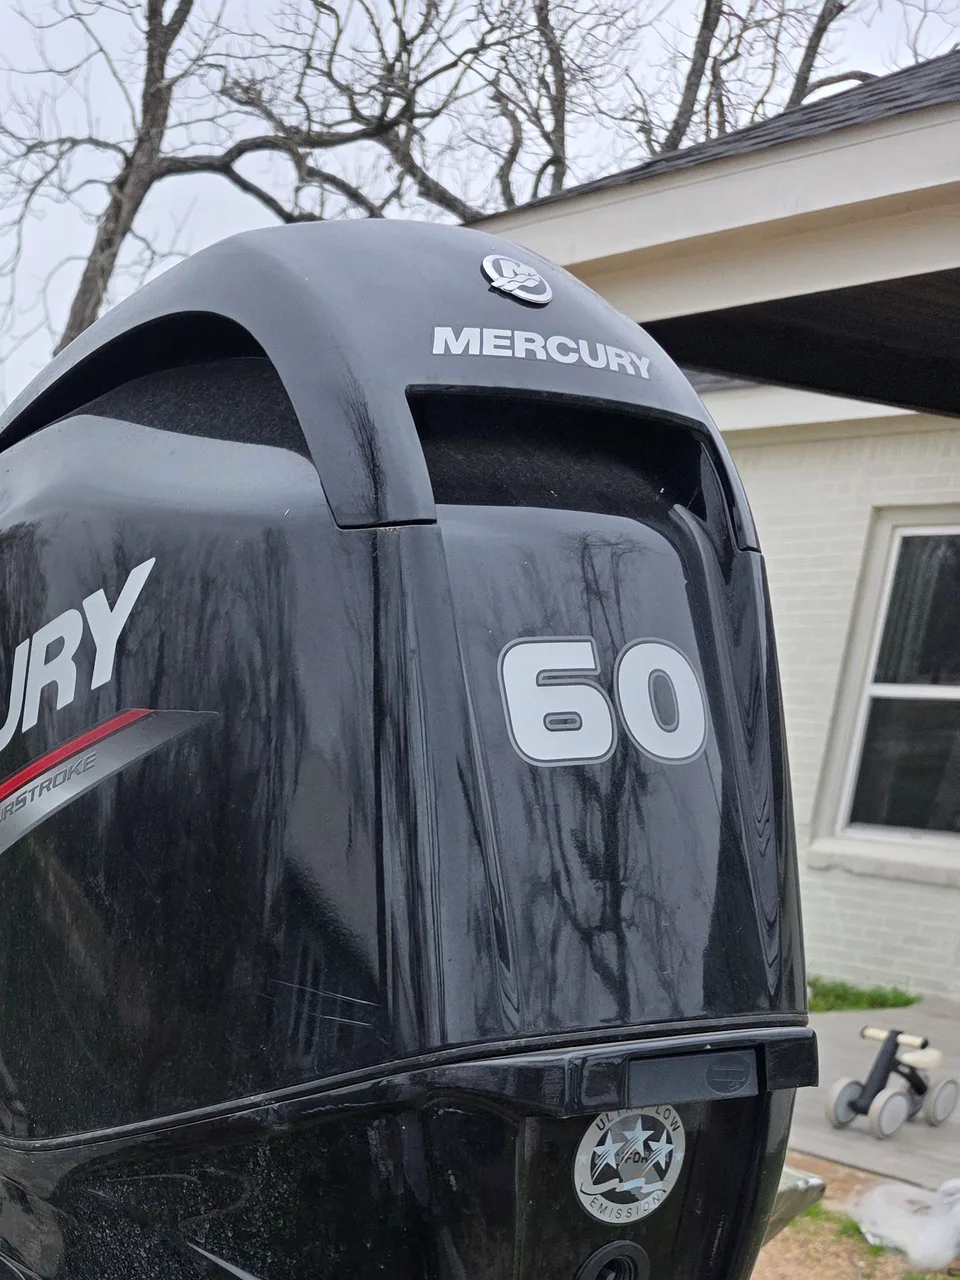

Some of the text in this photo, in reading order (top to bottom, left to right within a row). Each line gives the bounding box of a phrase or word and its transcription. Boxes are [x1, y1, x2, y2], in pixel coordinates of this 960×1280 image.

[433, 326, 650, 379] MERCURY
[500, 638, 706, 763] 60
[655, 1104, 681, 1132] LOW
[590, 1193, 661, 1219] EMISSION
